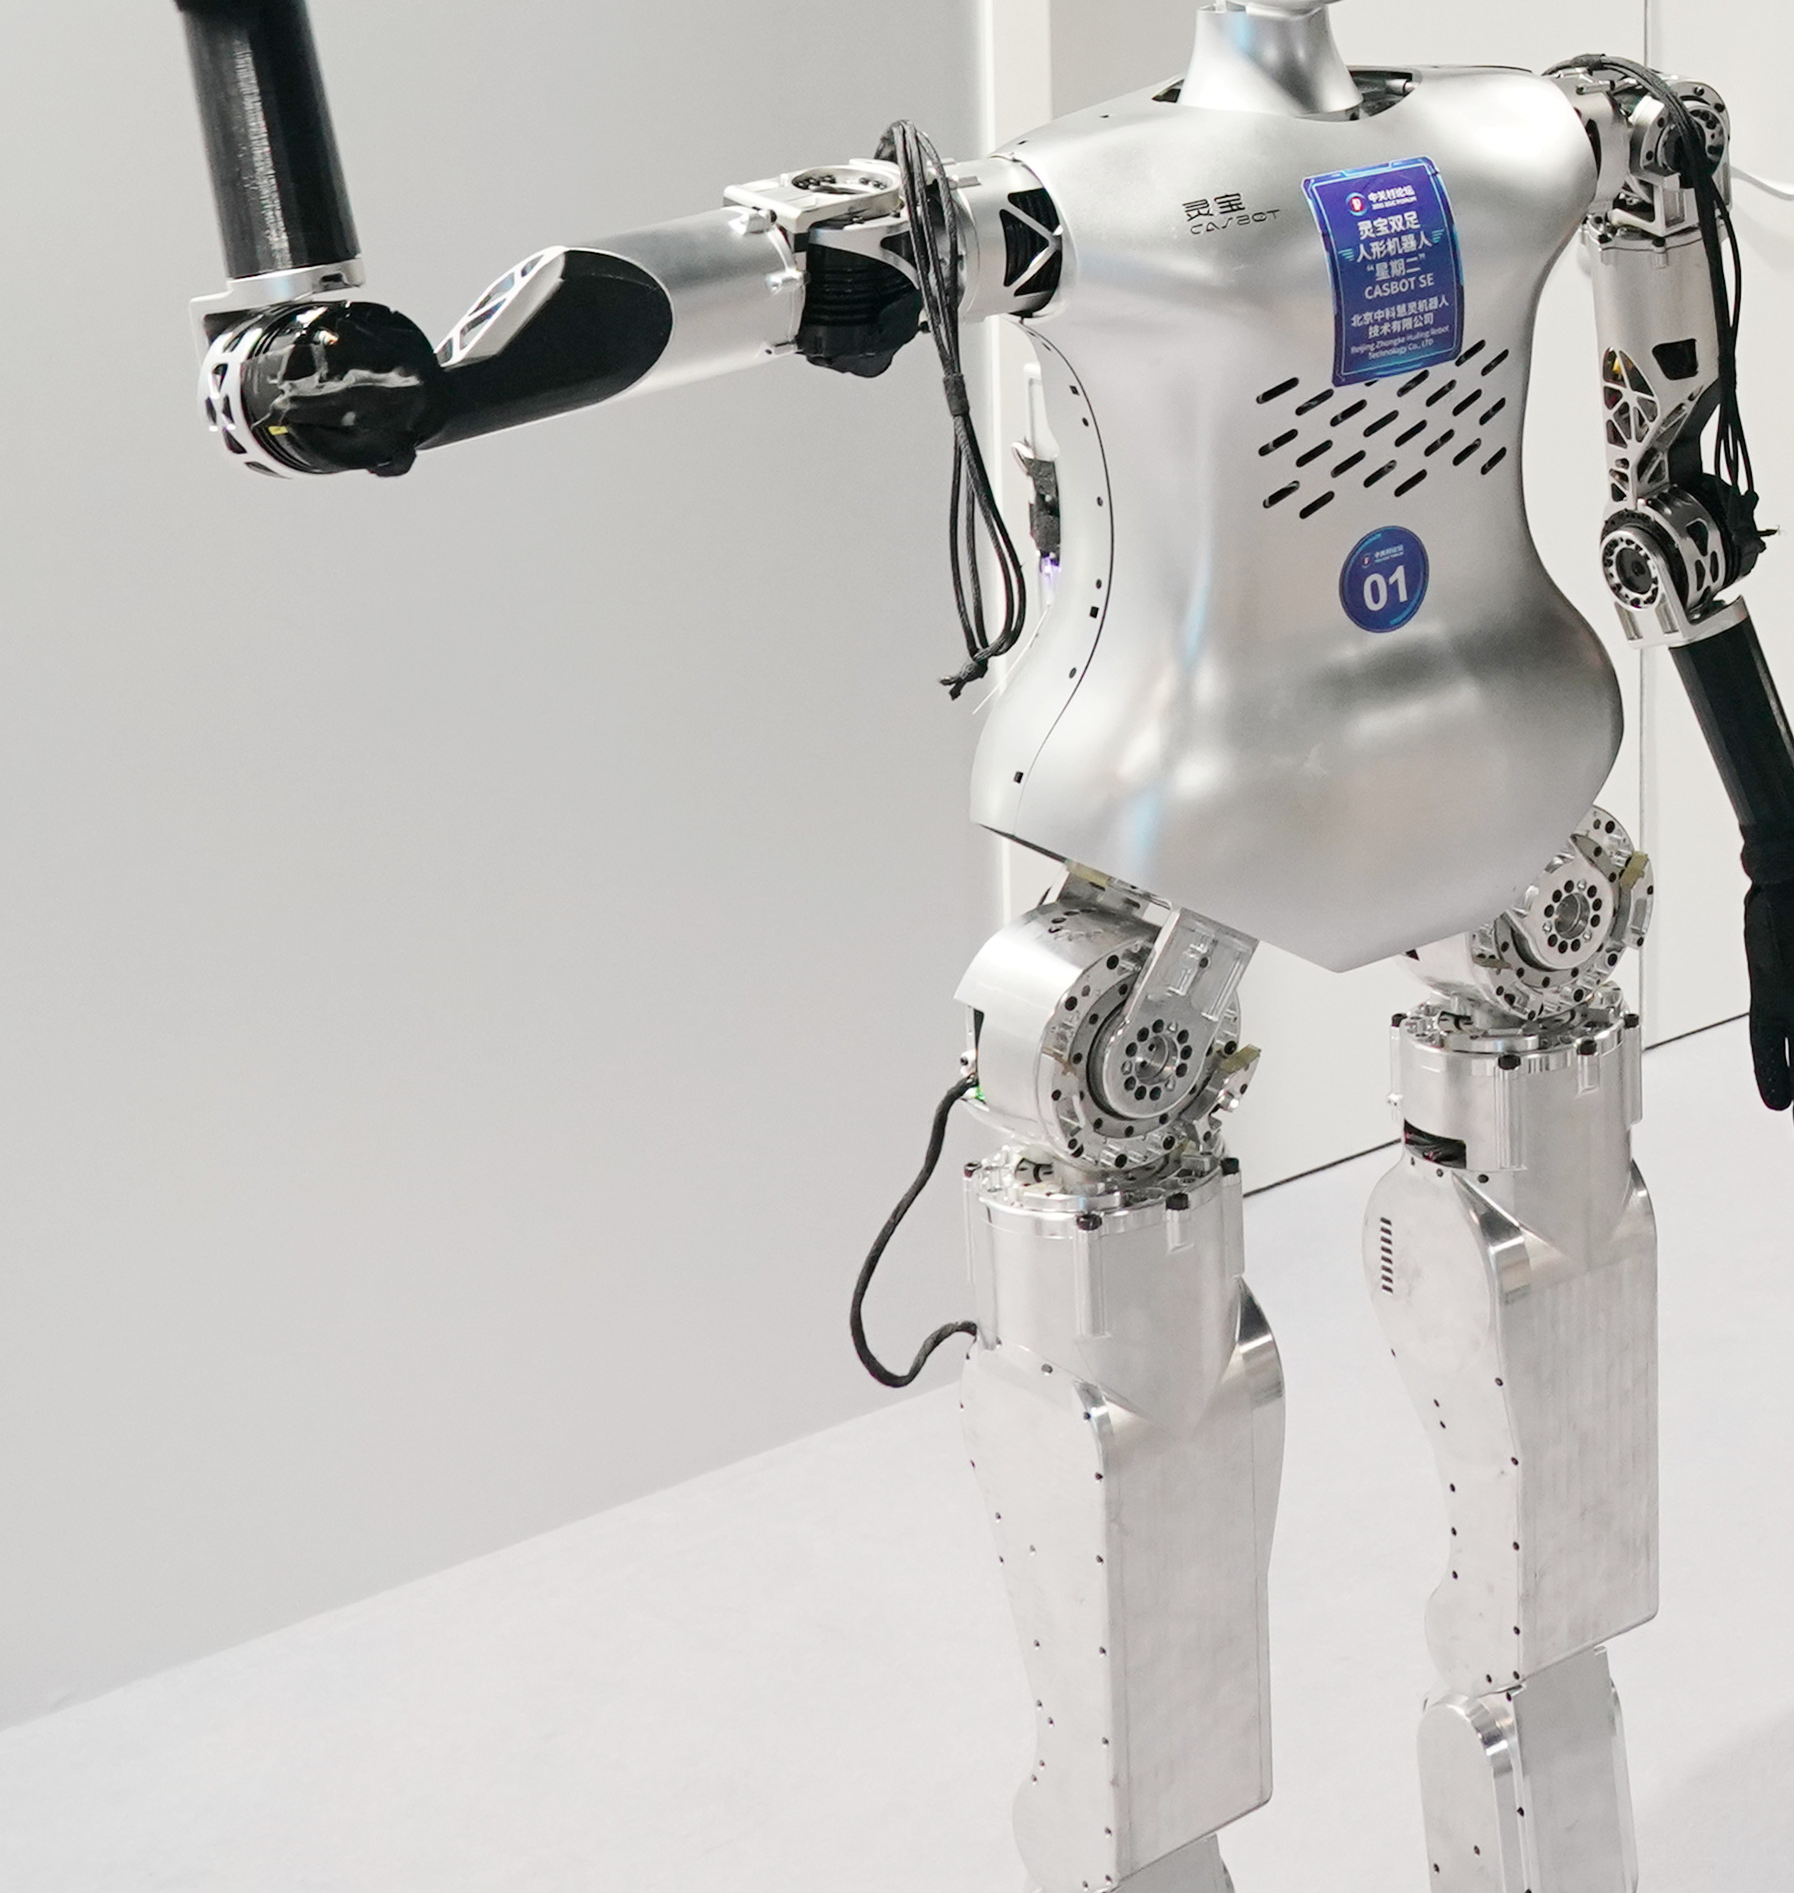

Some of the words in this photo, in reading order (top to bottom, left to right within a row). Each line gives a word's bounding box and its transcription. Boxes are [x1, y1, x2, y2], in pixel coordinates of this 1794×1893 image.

[1182, 193, 1246, 221] 灵宝
[1190, 209, 1280, 235] CASBOT
[1357, 211, 1421, 240] 灵宝双足
[1356, 230, 1433, 263] 人形机器人
[1364, 277, 1416, 299] CASBOT
[1418, 273, 1435, 288] SE
[1351, 294, 1449, 327] 北京中科慧灵机器人
[1368, 312, 1434, 339] 技术有限公司
[1363, 565, 1409, 611] 01
